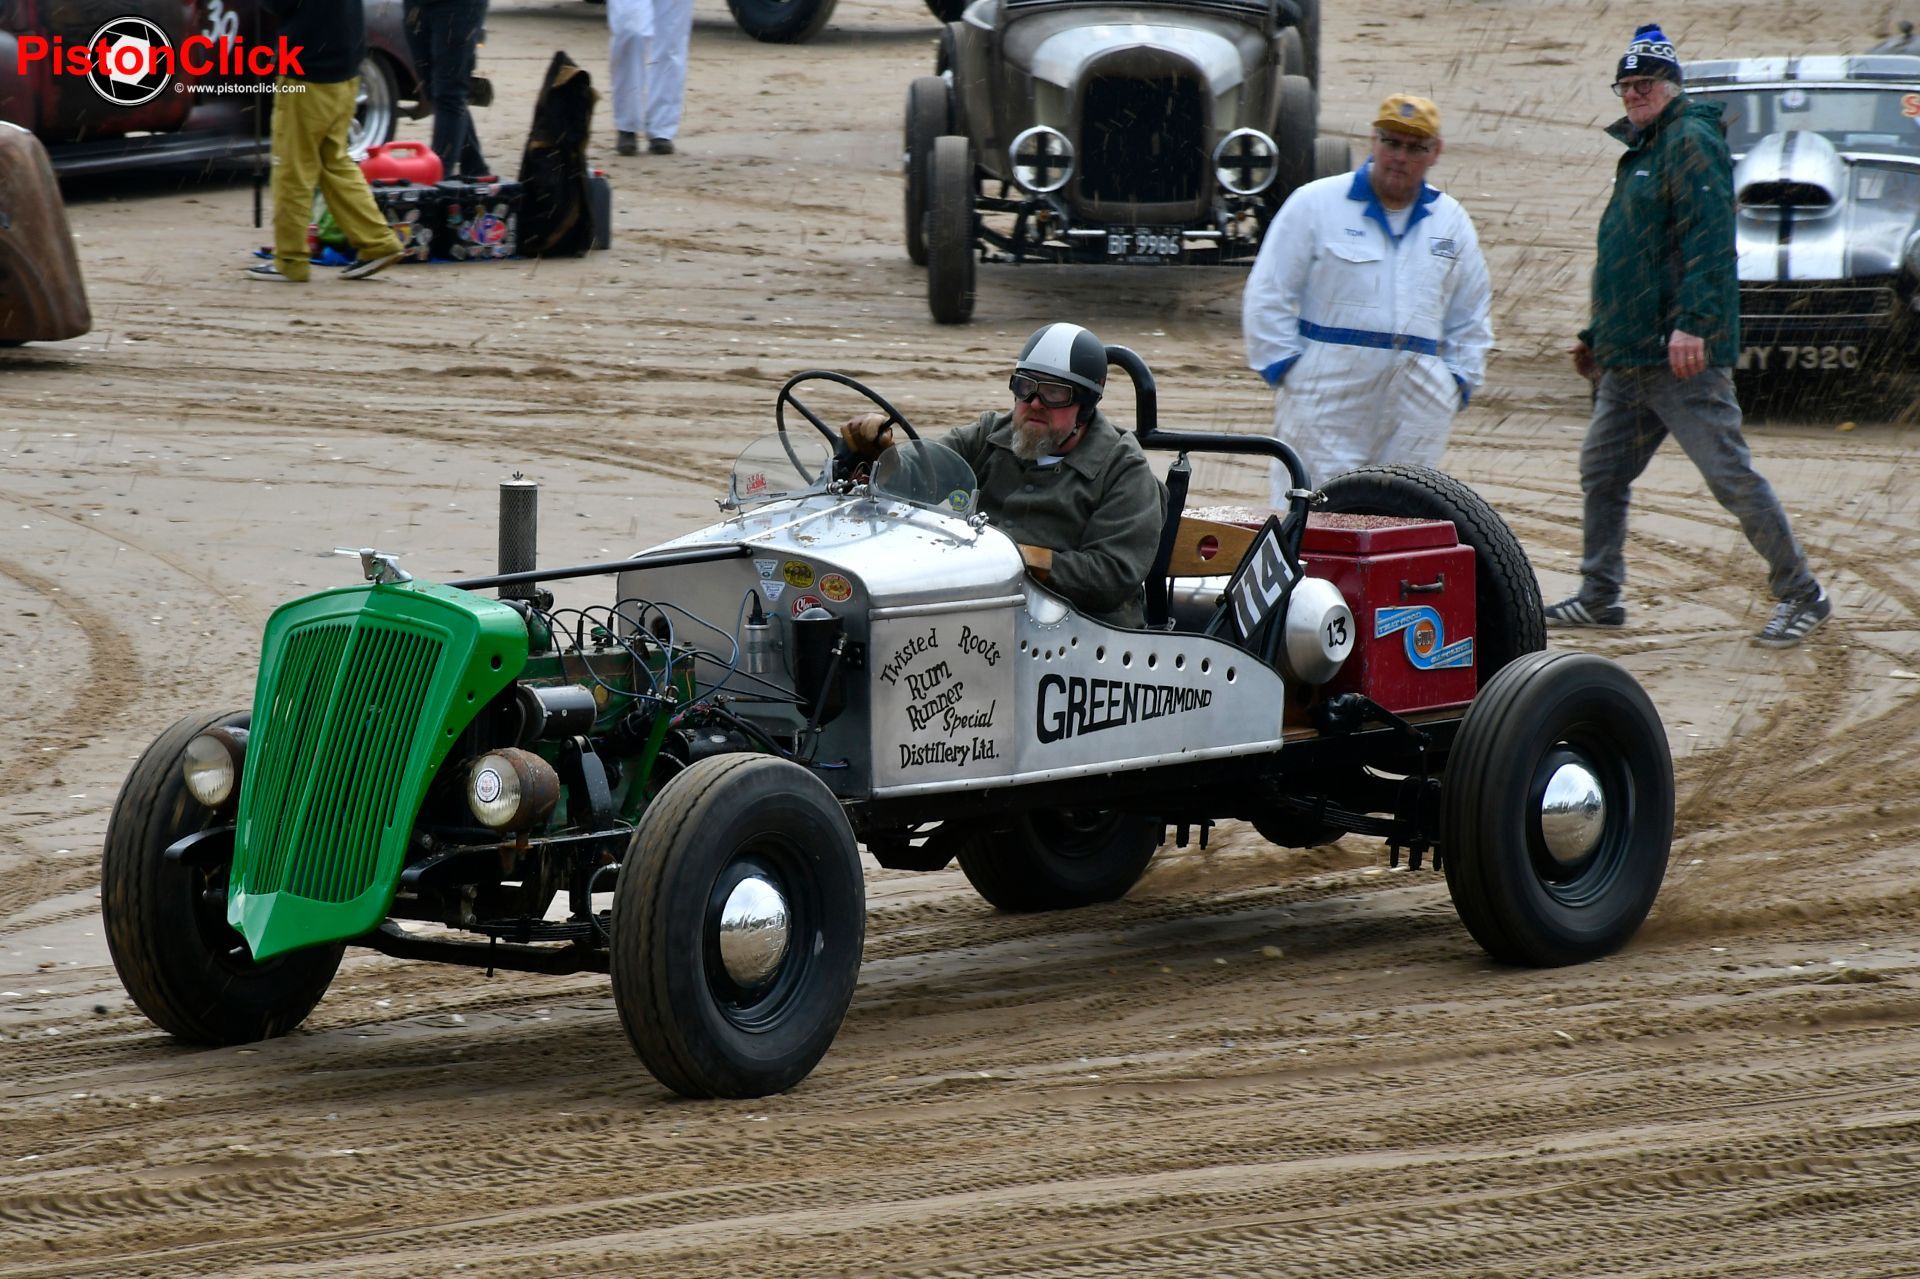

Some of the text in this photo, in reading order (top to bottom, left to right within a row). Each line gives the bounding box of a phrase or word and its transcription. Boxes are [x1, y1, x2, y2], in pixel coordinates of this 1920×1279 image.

[1779, 345, 1859, 369] 732C
[1232, 537, 1291, 635] 114
[1327, 616, 1348, 648] 13
[880, 625, 1001, 686] Twisted Roots
[904, 660, 953, 701] Rum
[906, 681, 964, 732] Runner
[943, 699, 997, 738] Special
[899, 737, 1000, 769] Distillery Ltd.
